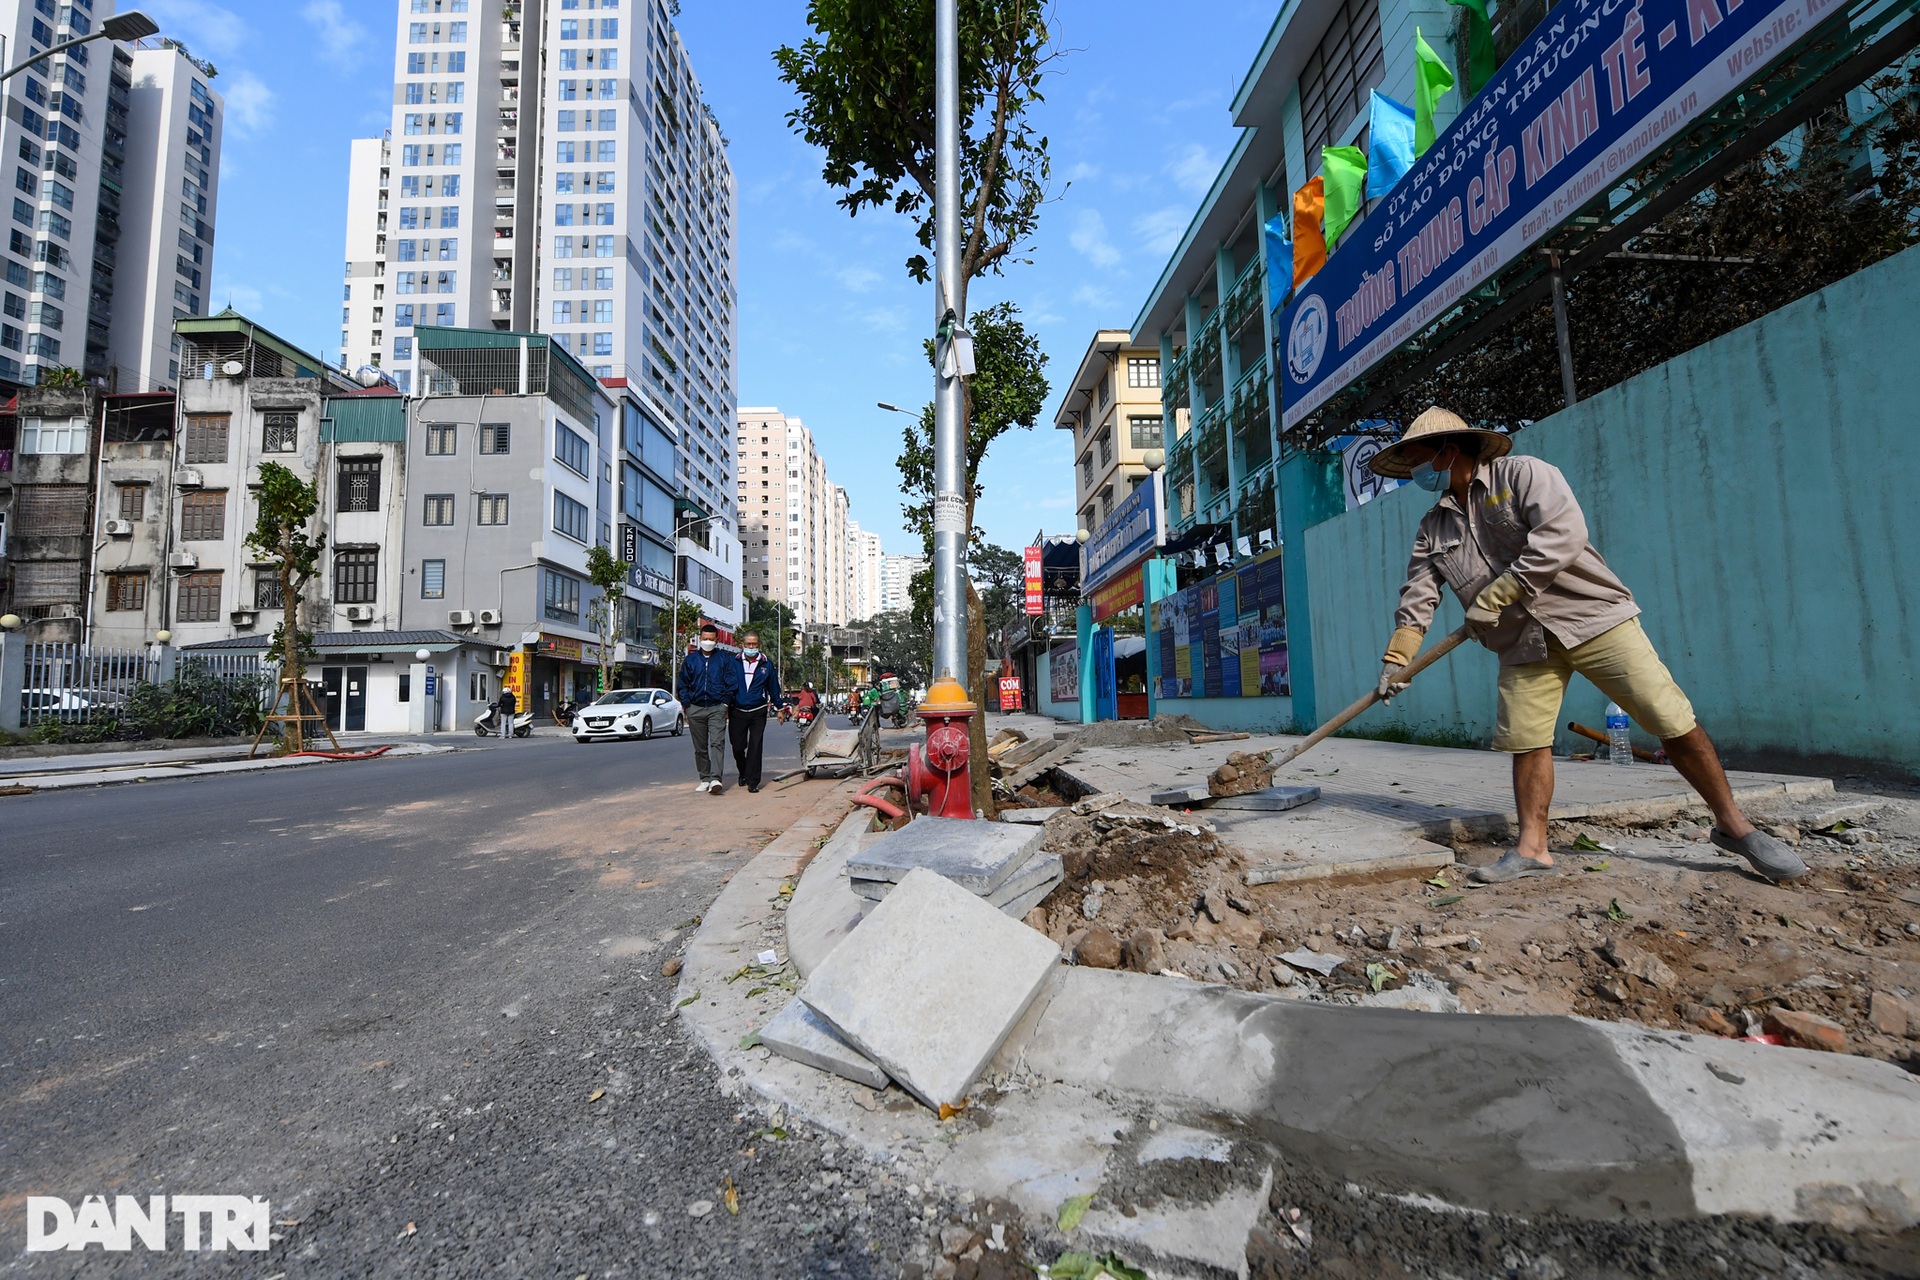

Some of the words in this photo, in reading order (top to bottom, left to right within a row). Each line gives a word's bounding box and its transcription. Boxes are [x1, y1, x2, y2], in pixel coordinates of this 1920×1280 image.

[1388, 192, 1408, 216] ỦY
[1413, 146, 1447, 190] BAN
[1452, 80, 1509, 147] NHÂN
[1515, 14, 1567, 81] DÂN
[1521, 207, 1553, 242] Email:
[1726, 9, 1802, 78] Website:
[1335, 260, 1396, 352] TRƯỜNG
[1397, 196, 1464, 297] TRUNG
[1467, 135, 1517, 237] CẤP
[1521, 64, 1600, 191] KINH
[1601, 0, 1651, 116] TẾ
[1657, 20, 1677, 52] -
[1373, 221, 1395, 253] SỞ
[1399, 186, 1432, 228] LAO
[1438, 117, 1499, 189] ĐỘNG
[1392, 318, 1411, 347] TRUNG
[1445, 274, 1465, 301] XUÂN
[1471, 258, 1482, 281] HÀ
[1483, 247, 1498, 271] NỘI
[626, 527, 634, 561] KREDO
[644, 573, 658, 591] STEVE
[1026, 560, 1041, 578] CƠM
[1000, 678, 1019, 690] CƠM
